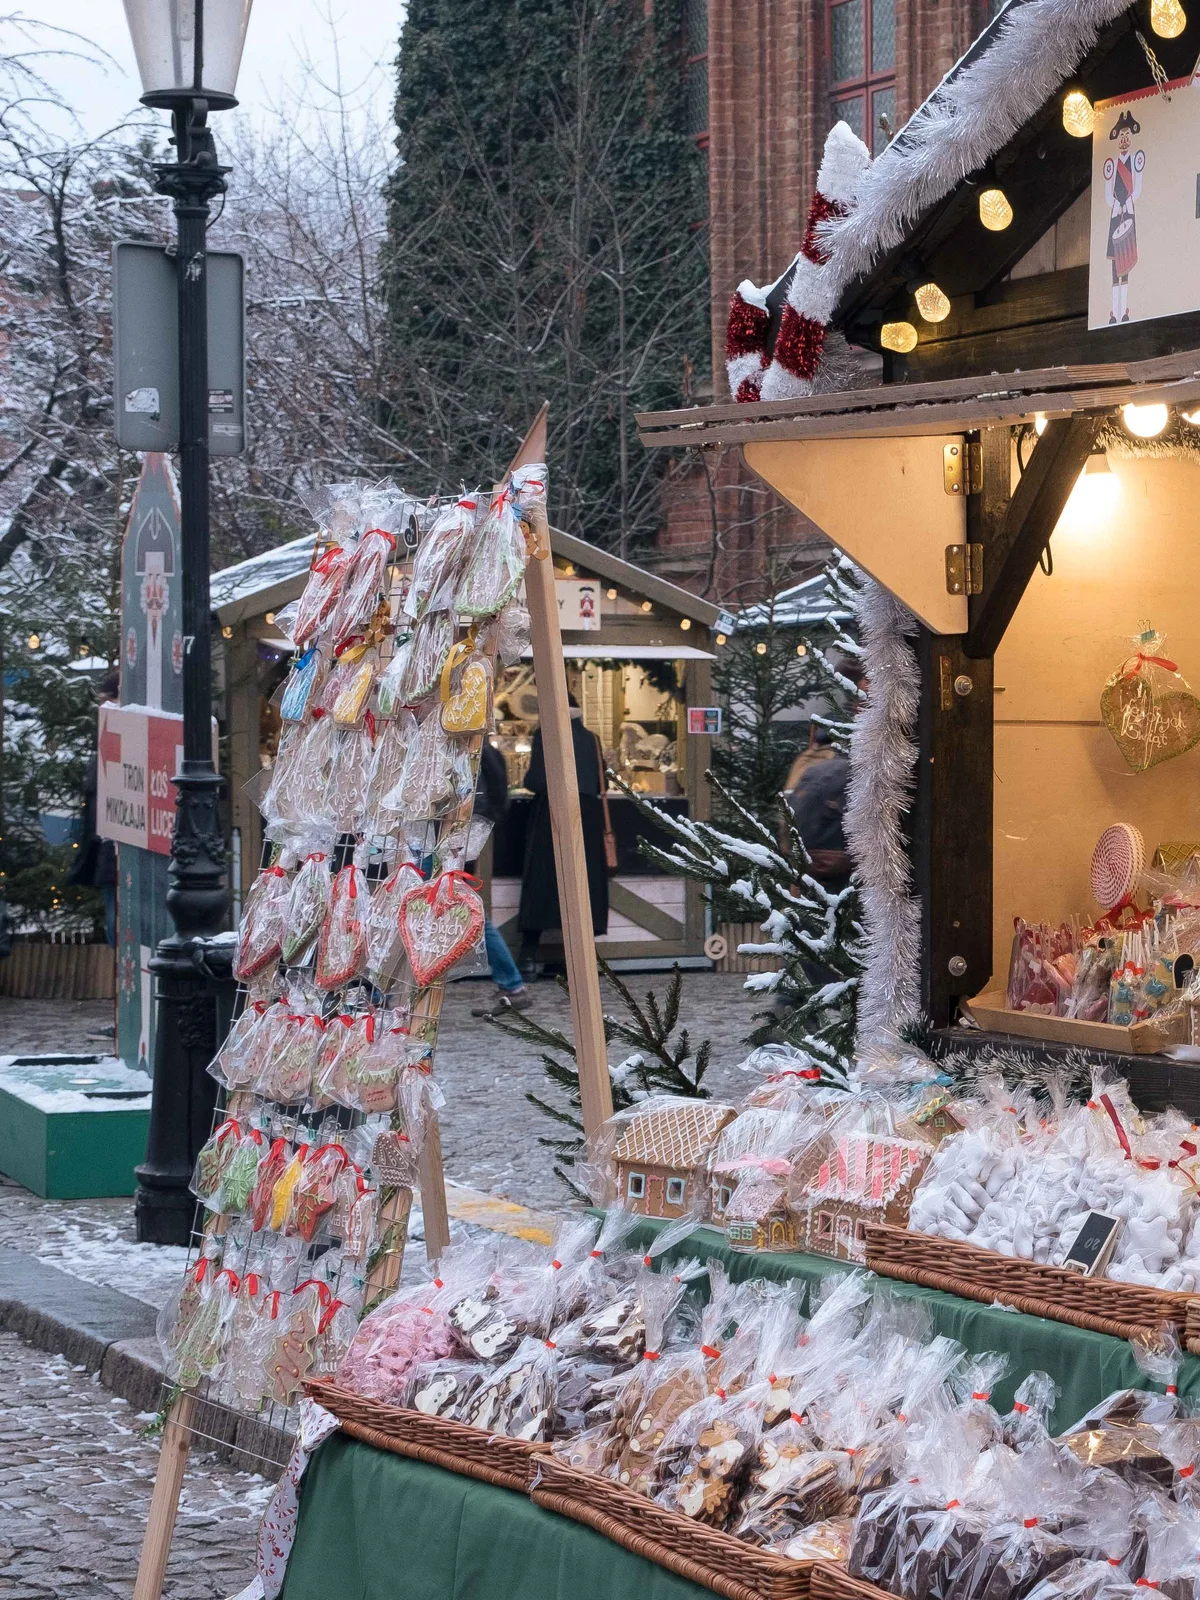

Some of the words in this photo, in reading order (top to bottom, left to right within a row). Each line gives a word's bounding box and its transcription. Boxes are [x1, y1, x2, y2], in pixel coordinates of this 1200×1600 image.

[123, 763, 145, 792] TRON
[150, 765, 168, 798] ŁOŚ
[106, 796, 146, 831] MIKOŁAJA
[151, 808, 177, 839] LUCE
